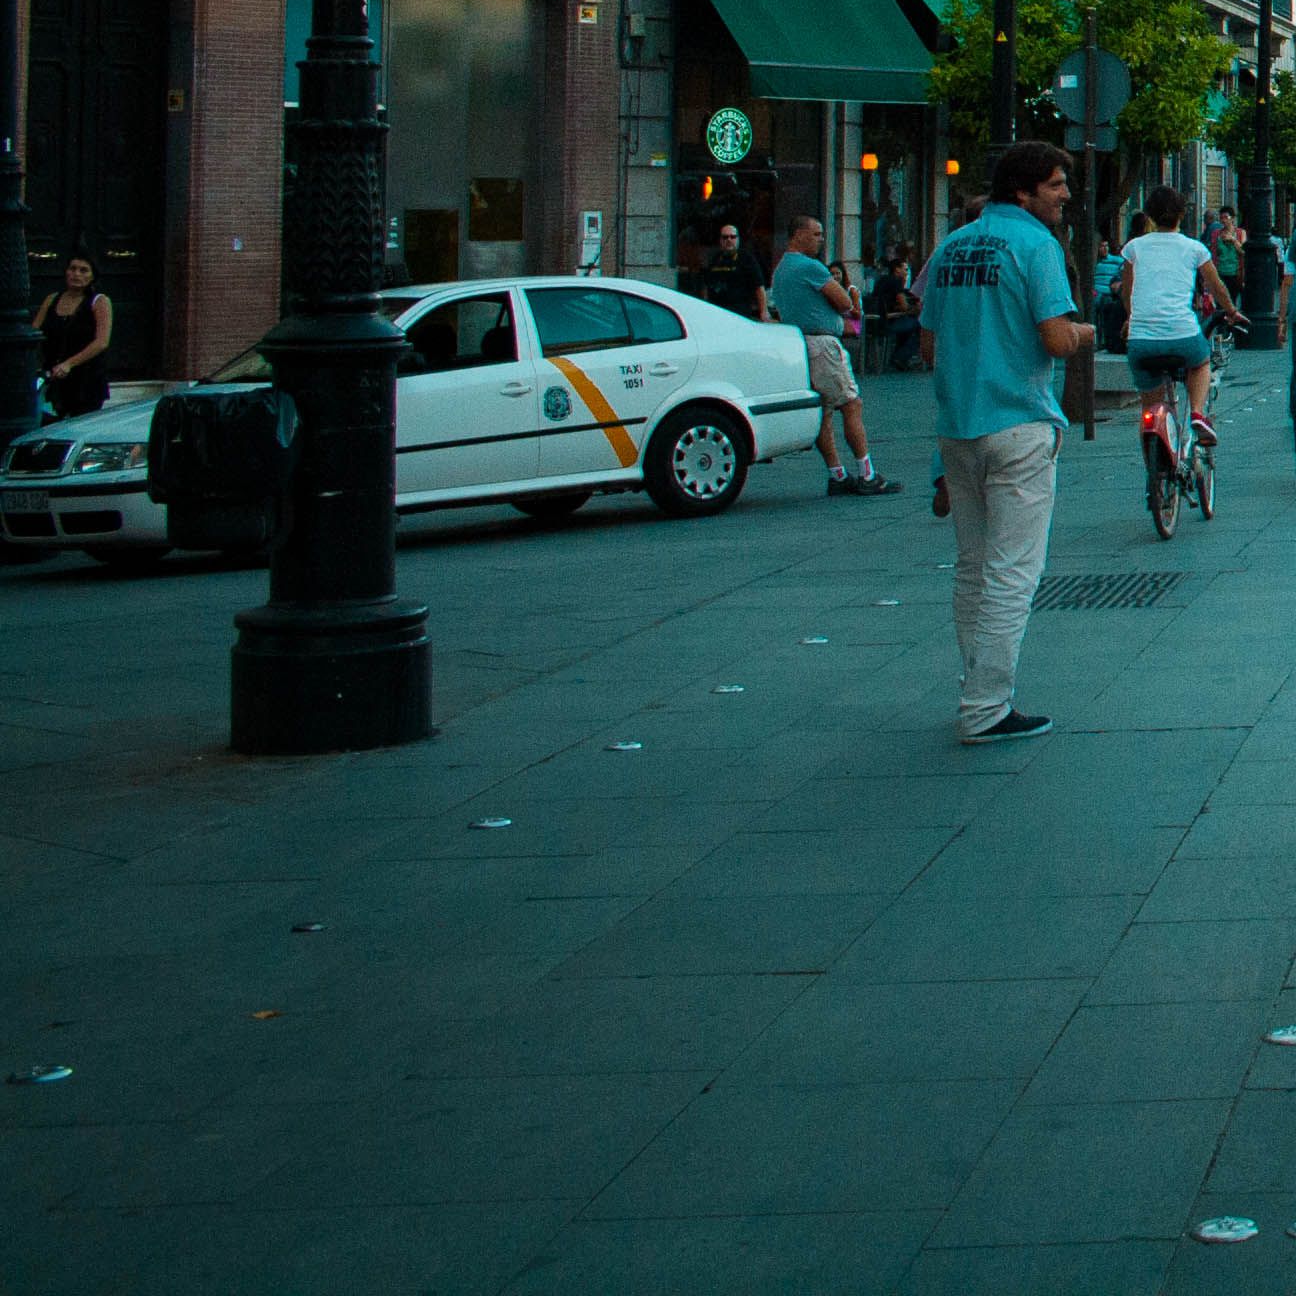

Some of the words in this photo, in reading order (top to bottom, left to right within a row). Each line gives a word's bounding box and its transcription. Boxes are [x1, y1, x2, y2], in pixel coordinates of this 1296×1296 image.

[710, 111, 749, 135] STARBUCKS
[714, 145, 743, 160] COFFEE
[619, 364, 643, 375] TAXI
[624, 378, 644, 389] 1051
